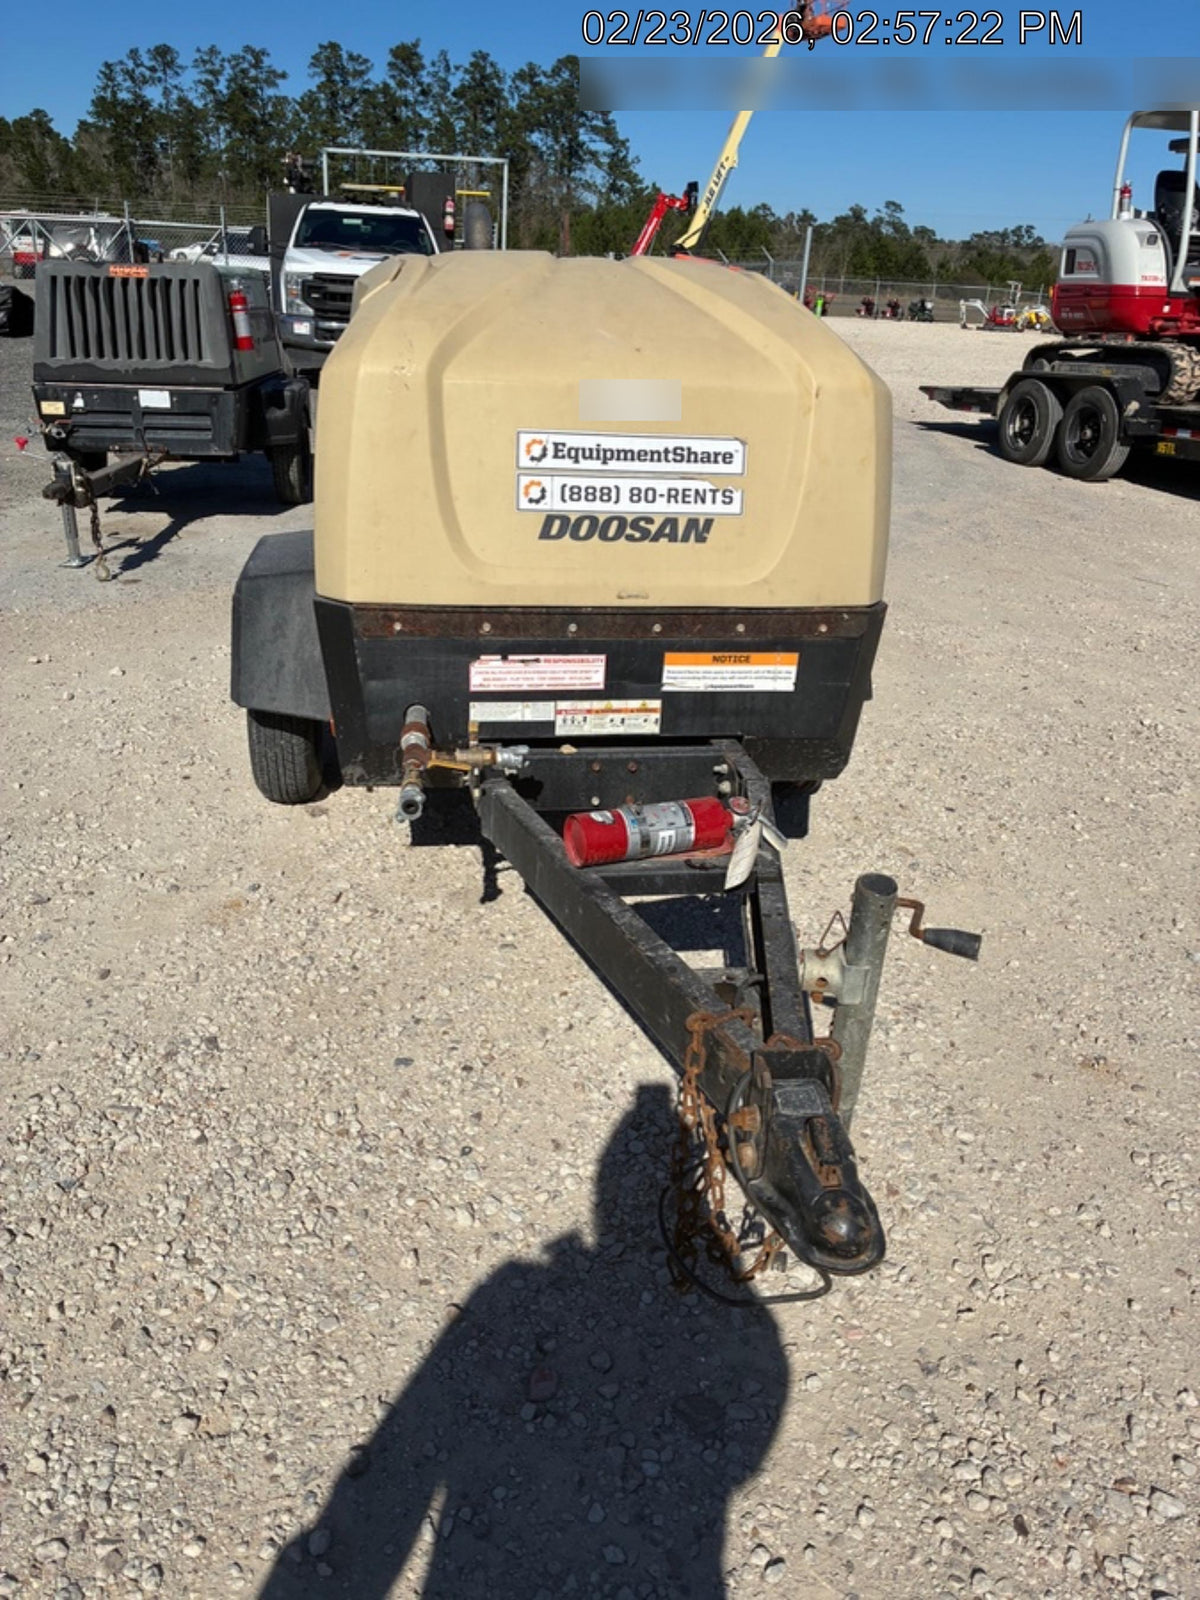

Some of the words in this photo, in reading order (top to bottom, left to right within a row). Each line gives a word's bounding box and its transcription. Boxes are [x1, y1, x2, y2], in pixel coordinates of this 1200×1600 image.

[552, 441, 735, 465] EquipmentShare
[560, 484, 621, 505] (888)
[628, 486, 734, 506] 80-RENTS
[538, 514, 715, 543] DOOSAN
[711, 654, 751, 664] NOTICE
